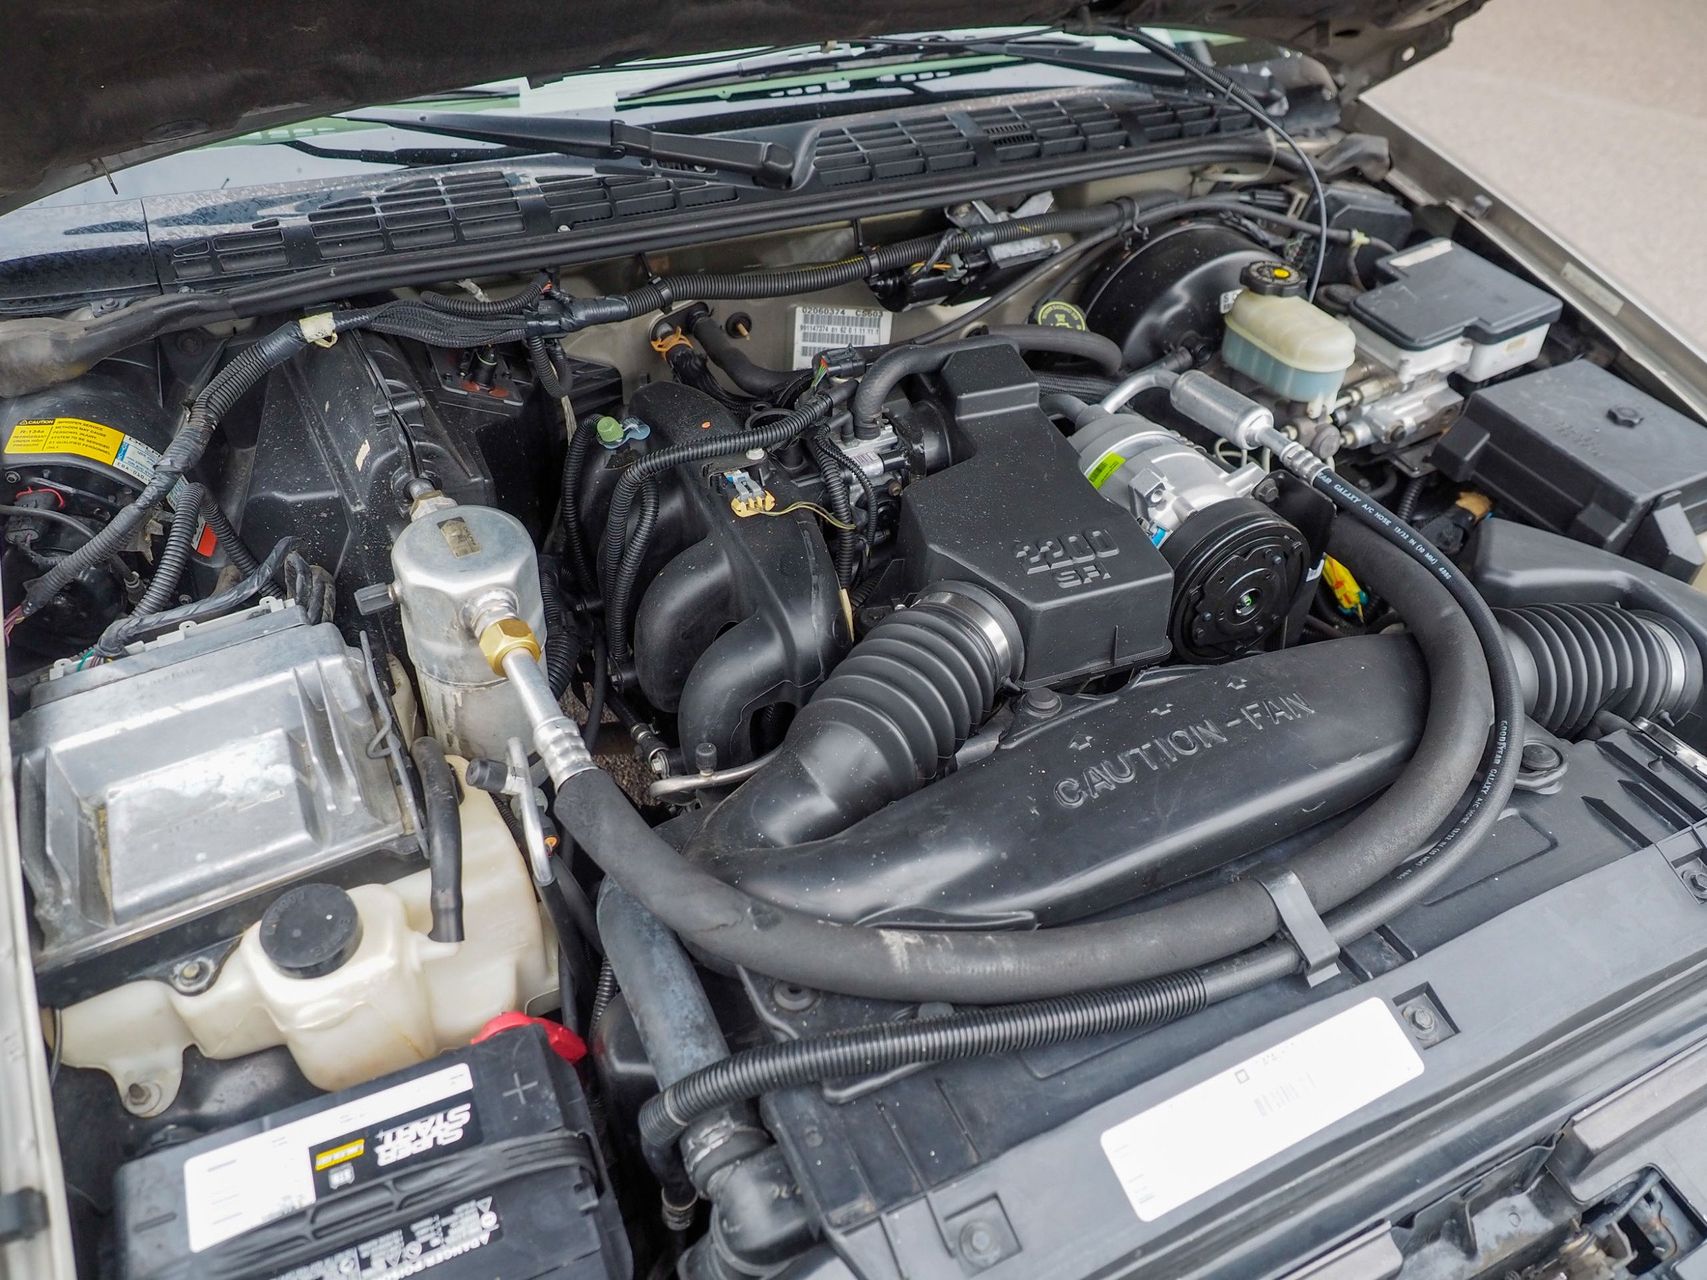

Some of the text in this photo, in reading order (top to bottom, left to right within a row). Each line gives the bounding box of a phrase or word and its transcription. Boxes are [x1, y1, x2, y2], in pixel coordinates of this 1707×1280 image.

[1333, 484, 1361, 504] GALAXY
[1361, 503, 1375, 514] A/C
[1374, 512, 1392, 526] HOSE
[1014, 529, 1120, 575] 2200
[1493, 720, 1508, 765] GOODYEAR
[1480, 768, 1498, 795] GALAXY
[382, 1102, 472, 1146] START
[374, 1127, 464, 1168] SUPER
